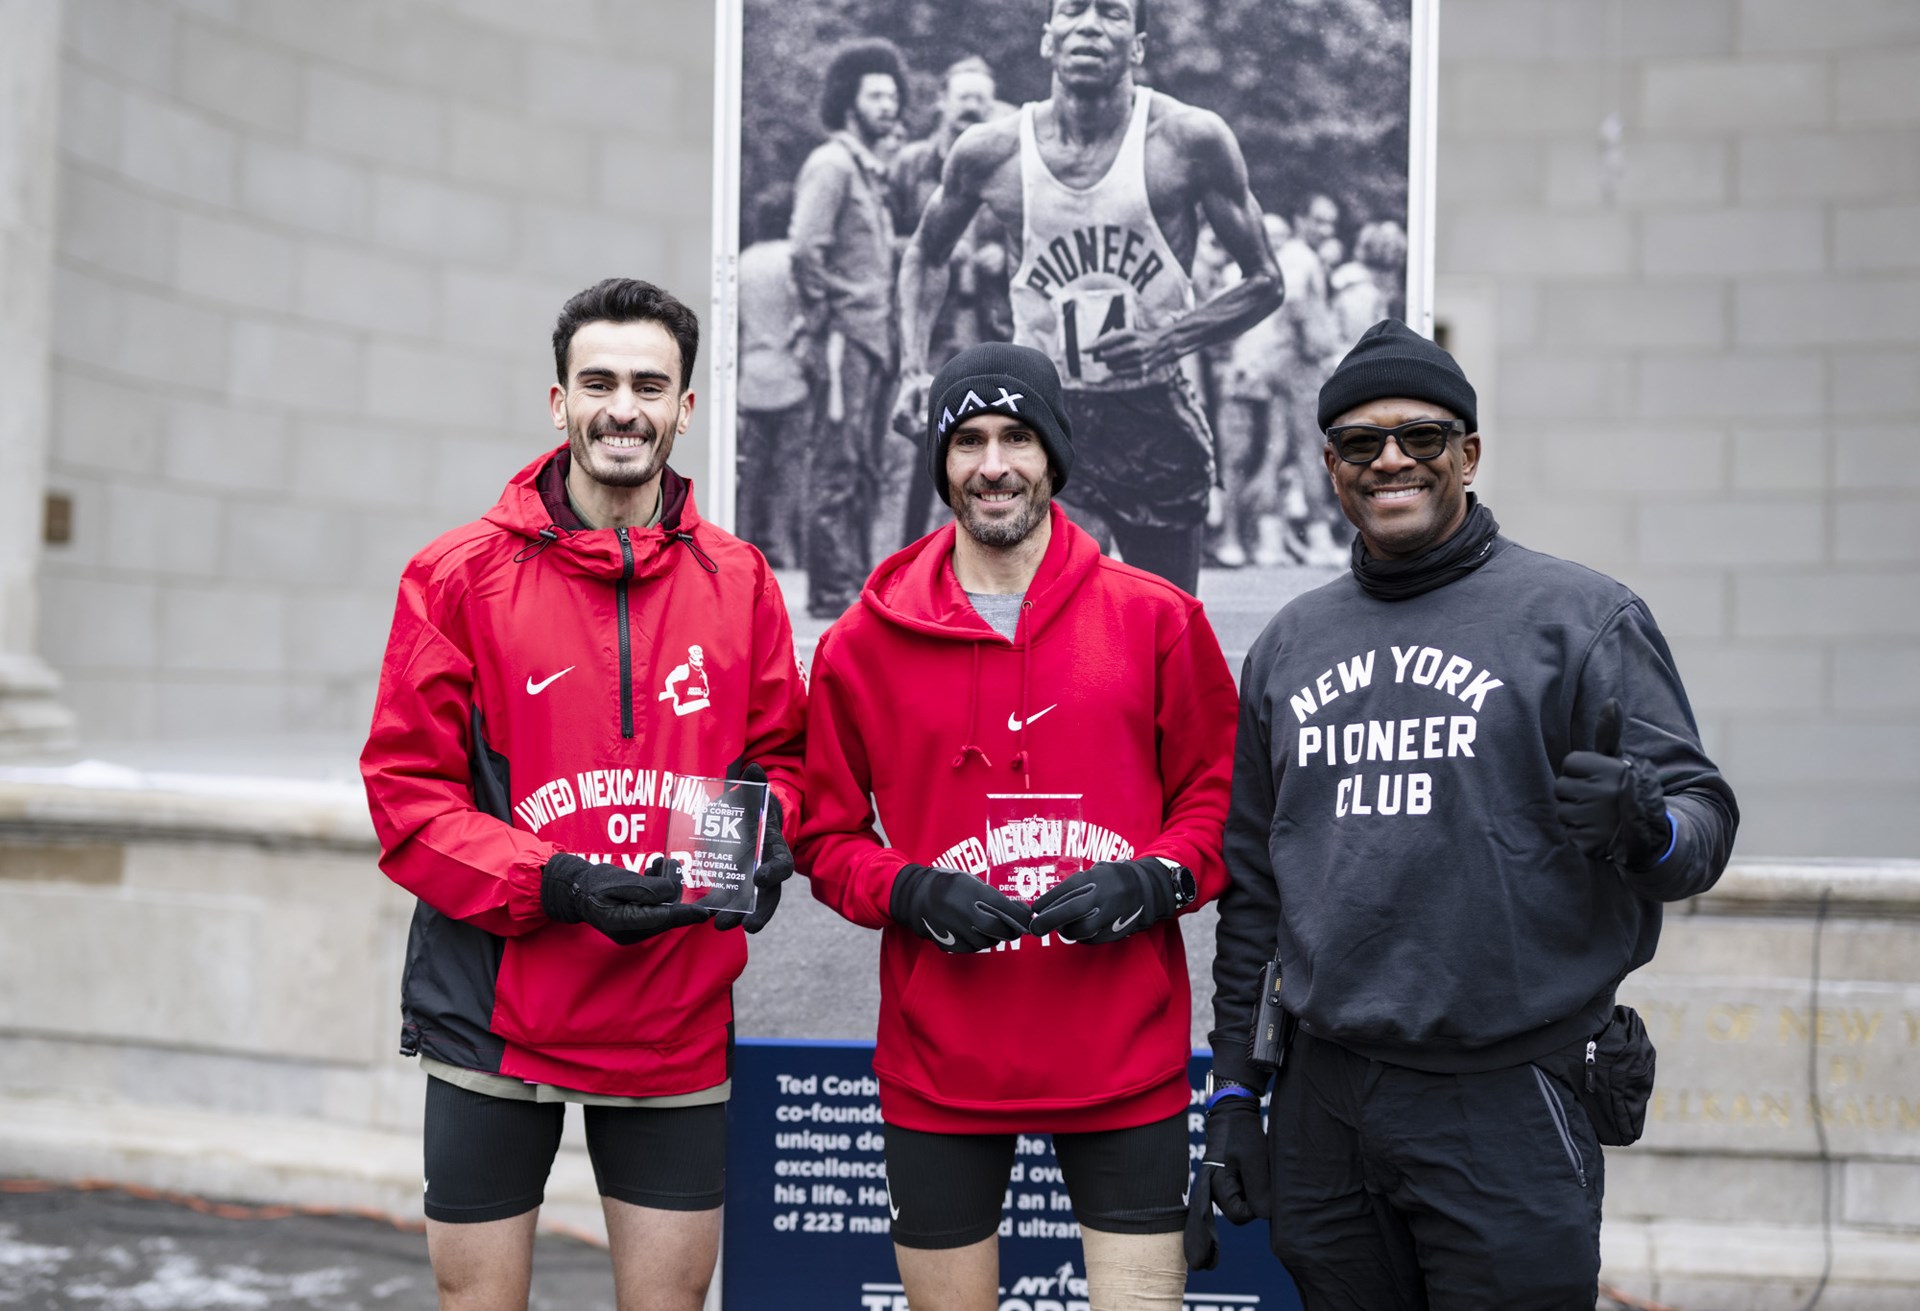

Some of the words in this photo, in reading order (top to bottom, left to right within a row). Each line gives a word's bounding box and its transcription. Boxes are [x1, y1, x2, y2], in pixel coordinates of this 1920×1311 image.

[1026, 224, 1163, 301] PIONEER
[1289, 650, 1376, 724] NEW
[1390, 645, 1504, 713] YORK
[1298, 715, 1477, 767] PIONEER
[514, 777, 577, 834] UNITED
[577, 768, 657, 810] MEXICAN
[1335, 773, 1432, 818] CLUB
[691, 812, 743, 840] 15K
[709, 807, 745, 818] CORBITT
[607, 813, 646, 844] OF
[703, 861, 738, 871] OVERALL
[708, 852, 733, 861] PLACE
[930, 836, 987, 875] NITED
[726, 873, 746, 881] 2025
[1017, 865, 1056, 898] OF
[1778, 1005, 1882, 1046] NEW
[776, 1074, 818, 1096] Ted
[775, 1129, 852, 1154] unique
[774, 1183, 807, 1205] his
[811, 1184, 853, 1206] life.
[858, 1186, 889, 1207] He
[773, 1211, 800, 1232] of
[802, 1212, 845, 1233] 223
